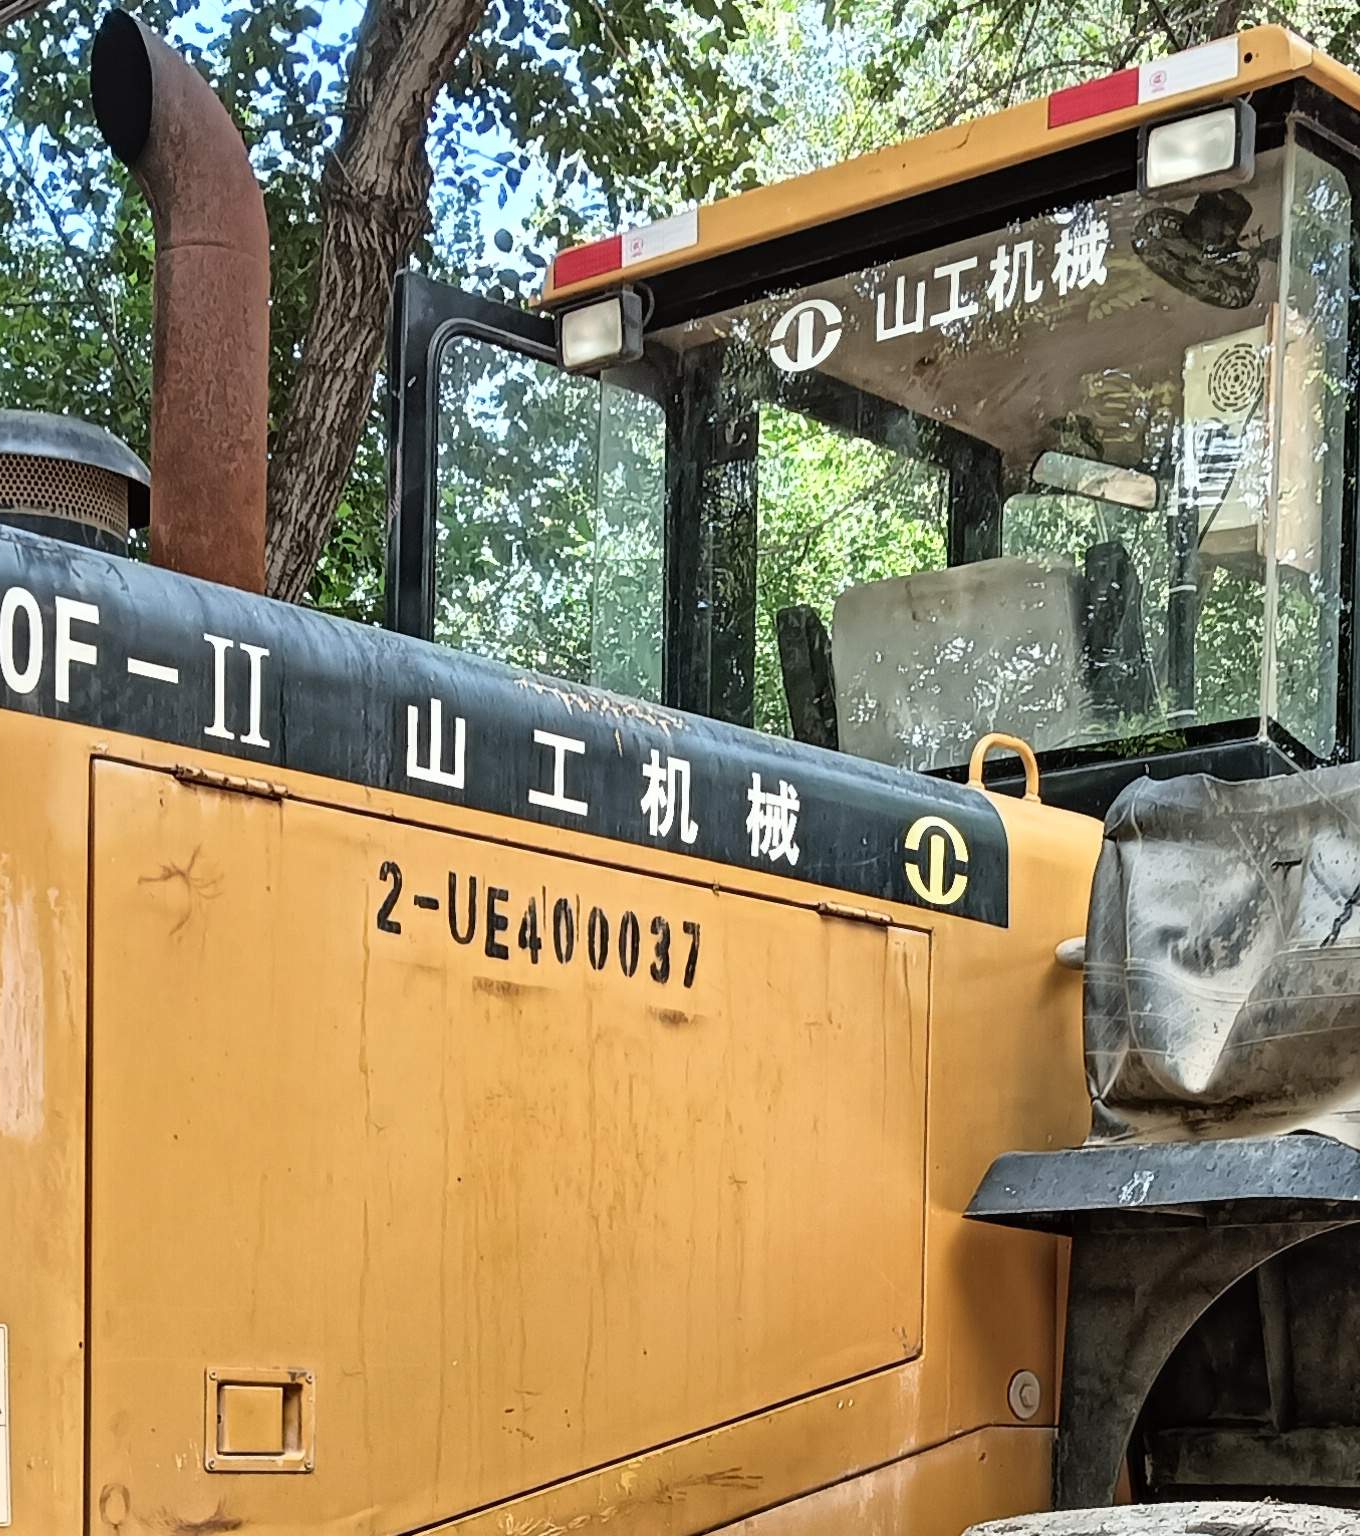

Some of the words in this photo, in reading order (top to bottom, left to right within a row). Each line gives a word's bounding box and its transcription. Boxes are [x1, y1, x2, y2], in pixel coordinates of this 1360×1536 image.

[874, 218, 1111, 343] 山工机械
[405, 697, 801, 866] 山工机械
[375, 860, 702, 989] 2-UE400037
